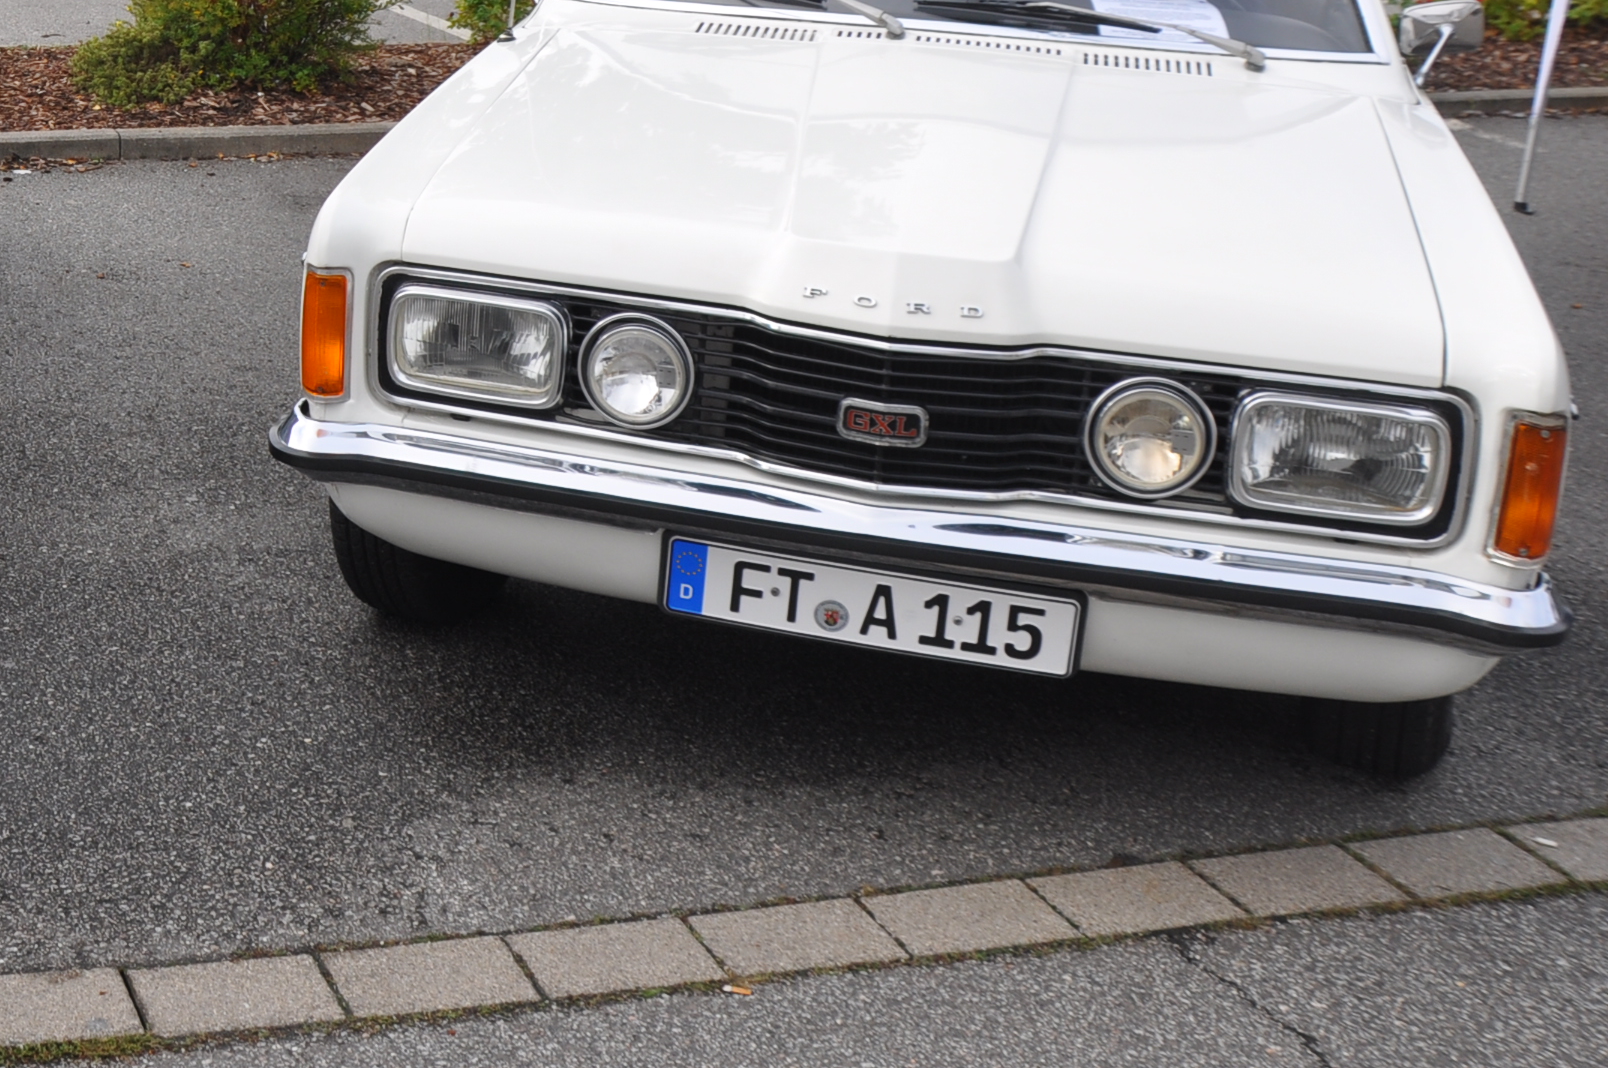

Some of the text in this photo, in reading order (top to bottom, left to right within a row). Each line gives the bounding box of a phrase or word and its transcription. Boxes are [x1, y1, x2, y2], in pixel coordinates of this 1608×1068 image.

[802, 286, 984, 318] FORD
[847, 410, 917, 437] GXL
[680, 584, 693, 600] D
[730, 560, 815, 624] FT
